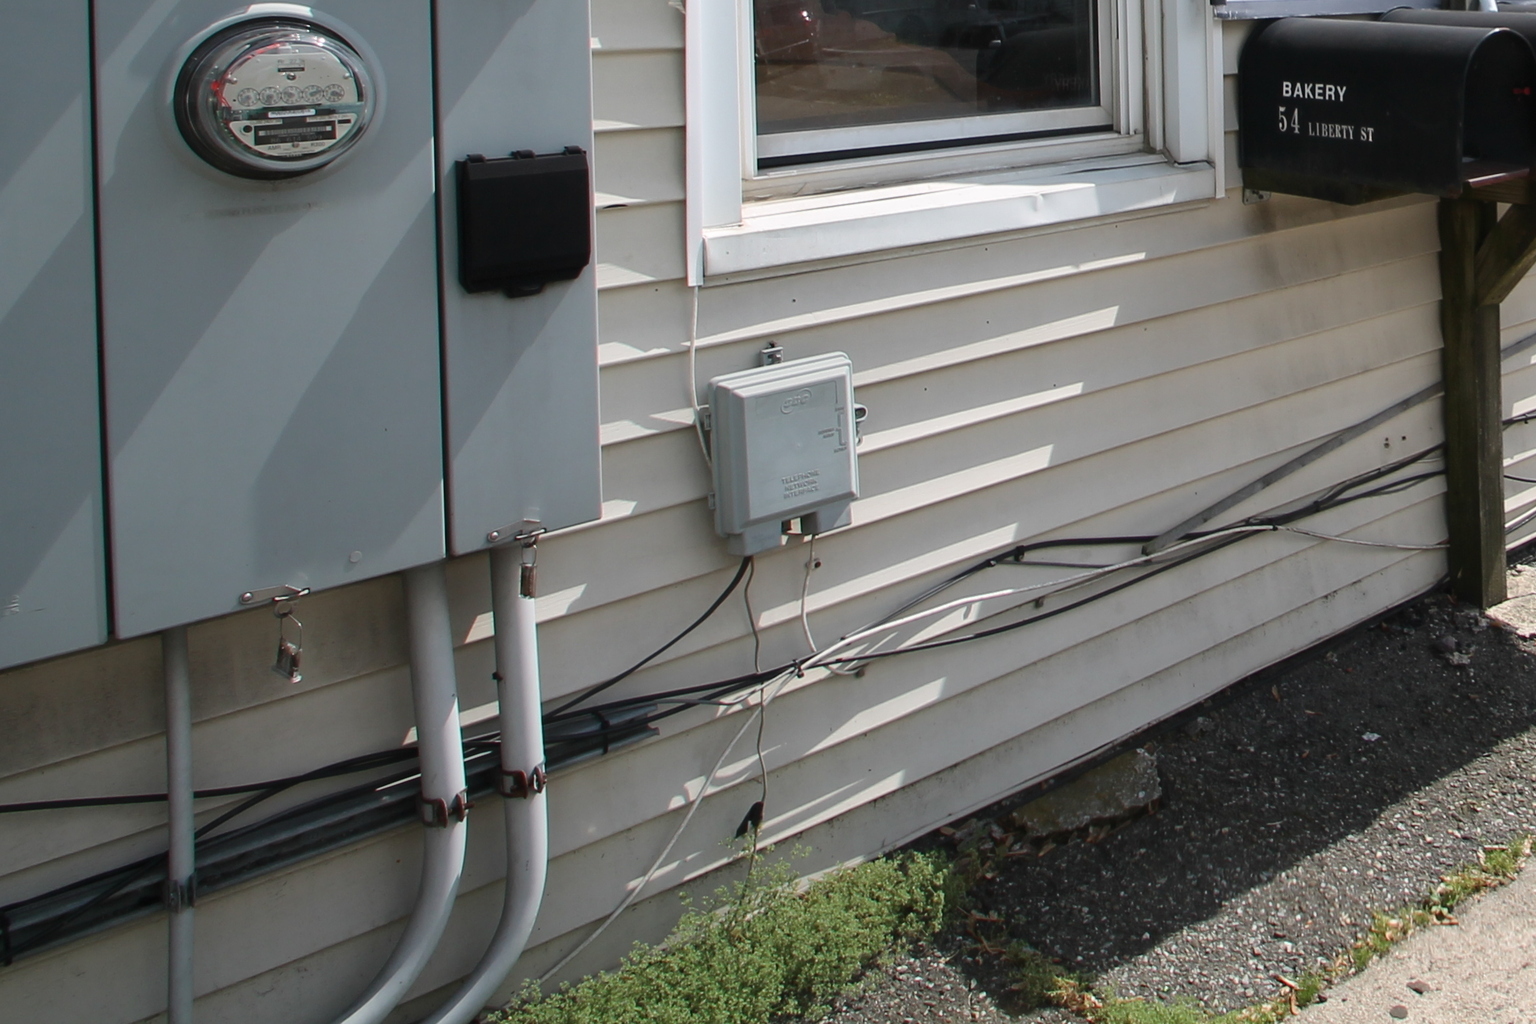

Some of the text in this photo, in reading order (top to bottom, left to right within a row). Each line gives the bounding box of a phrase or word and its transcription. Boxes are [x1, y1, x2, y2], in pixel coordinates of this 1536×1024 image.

[1283, 81, 1347, 102] BAKERY
[1279, 106, 1374, 142] 54 LIBERTY ST
